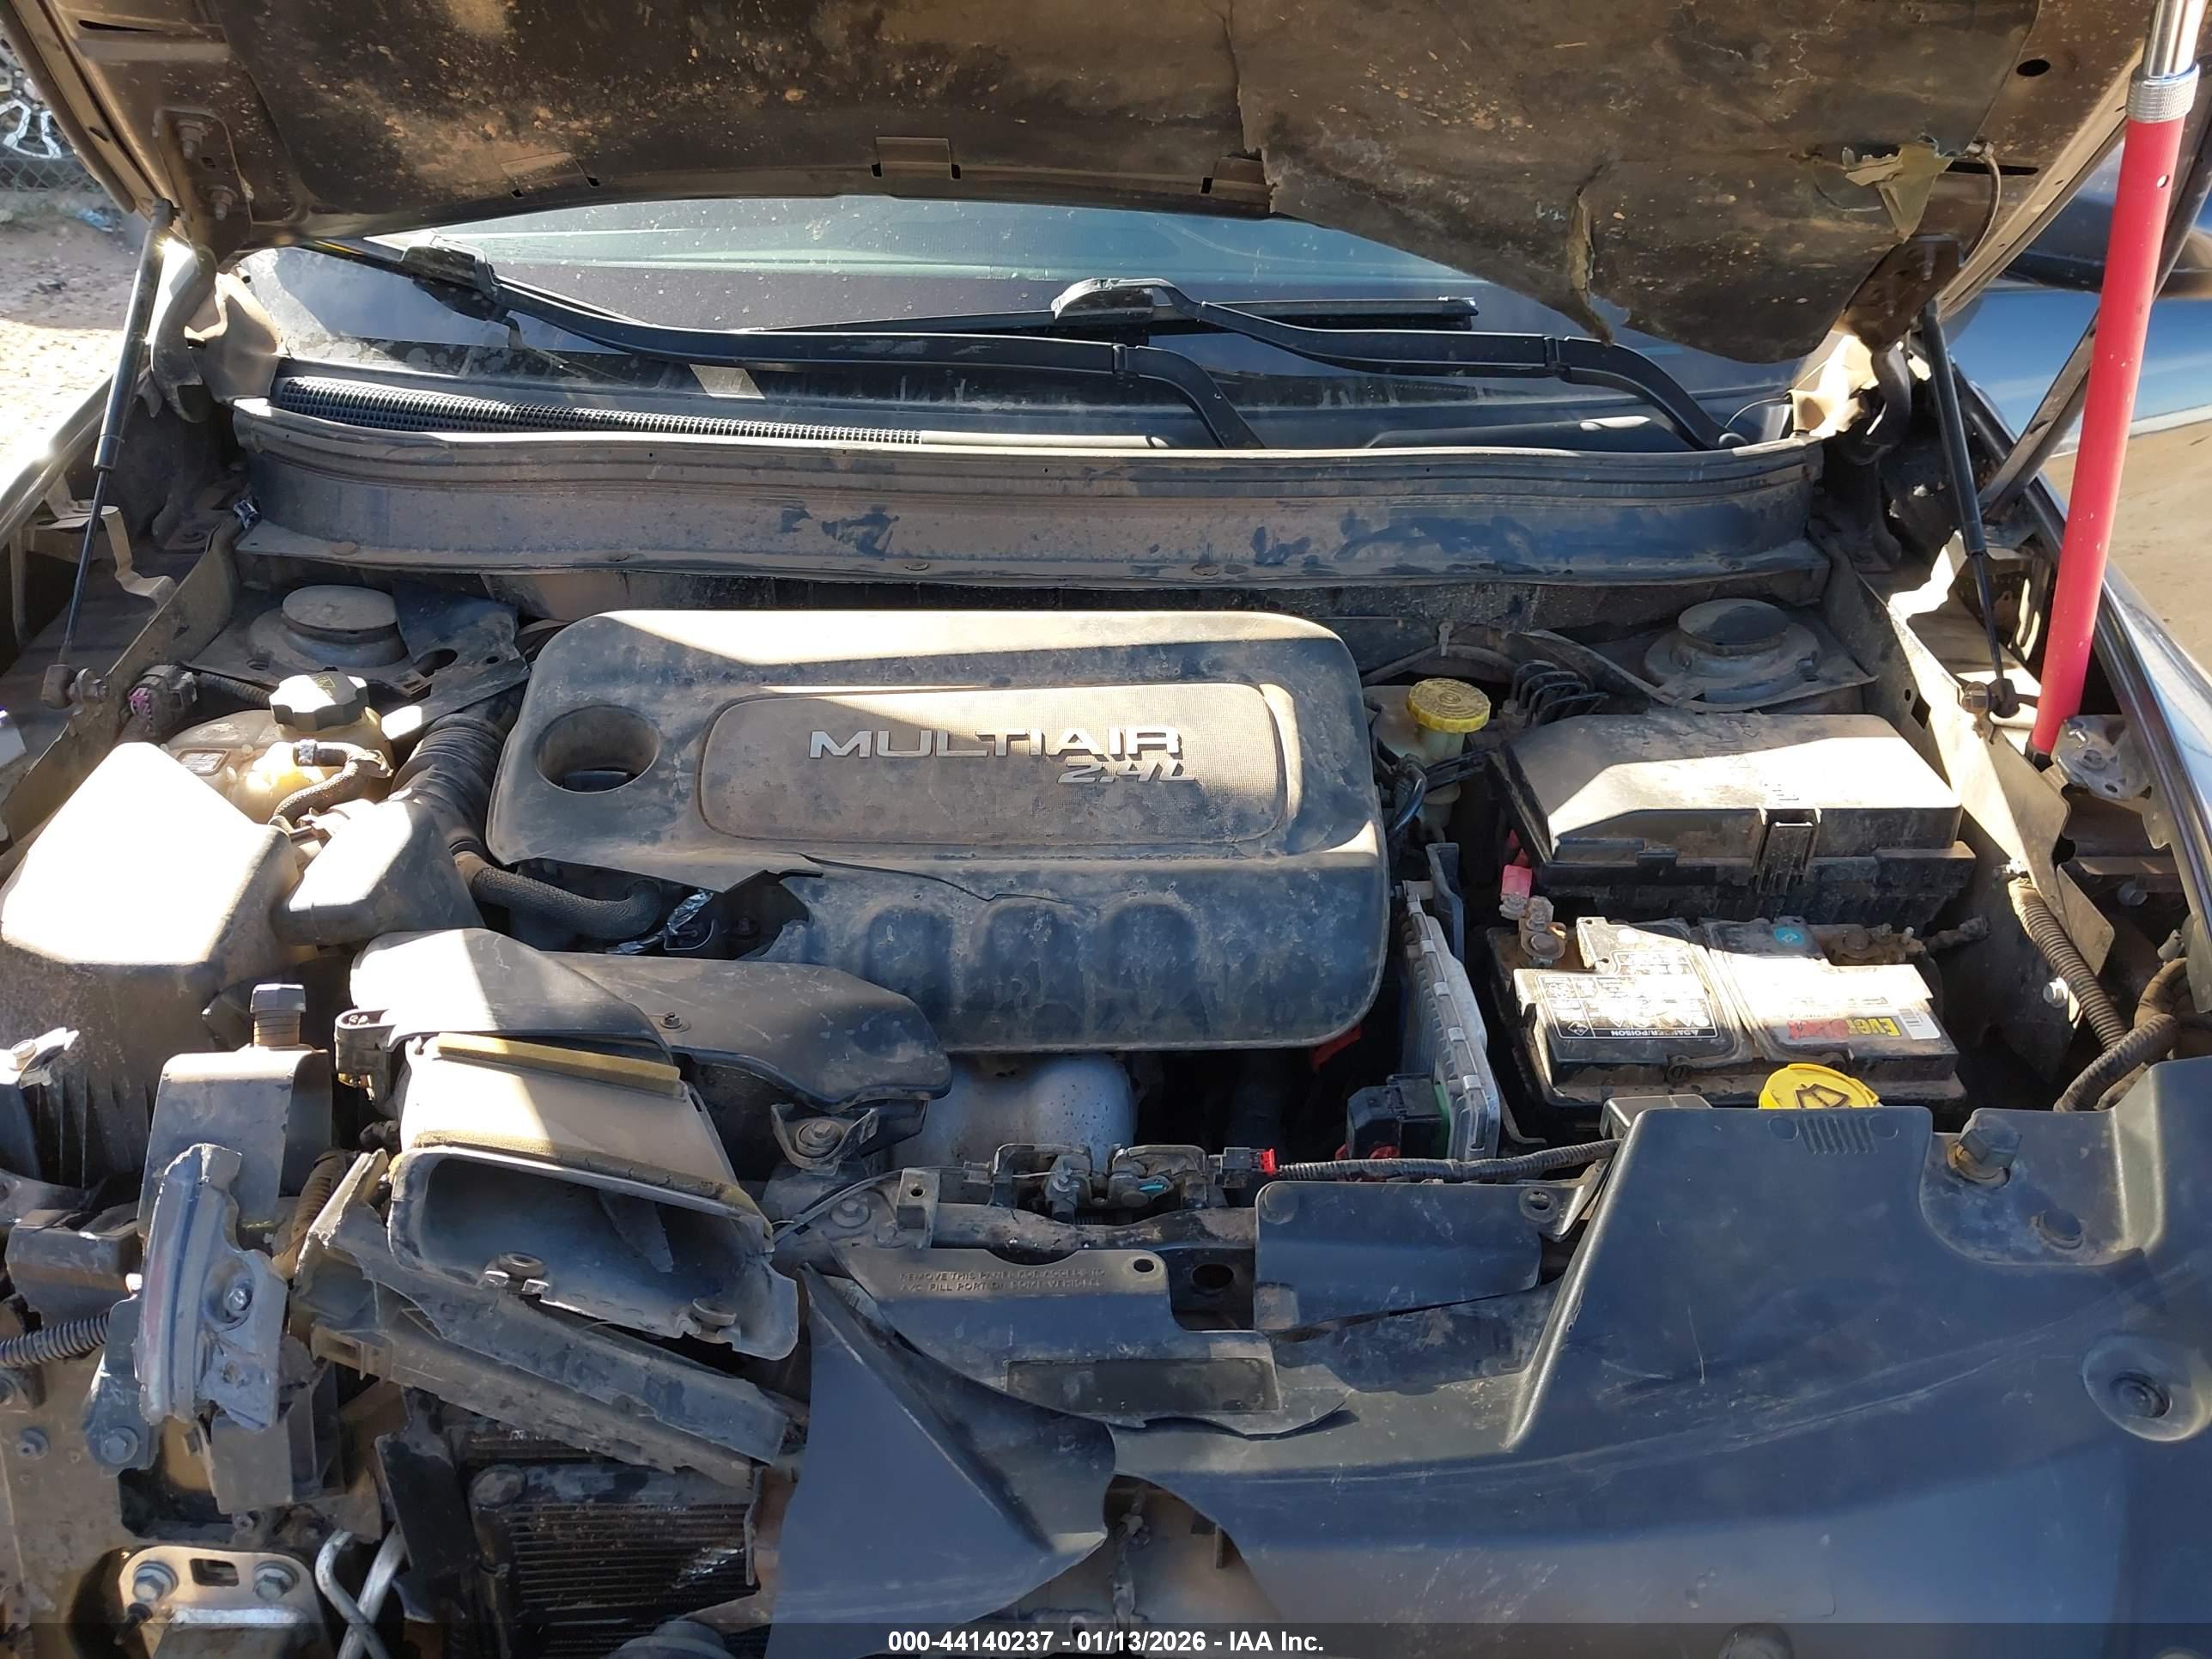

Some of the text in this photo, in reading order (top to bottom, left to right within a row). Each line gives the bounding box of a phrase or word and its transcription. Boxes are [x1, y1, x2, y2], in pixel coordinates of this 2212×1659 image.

[809, 726, 1182, 759] MULTIAIR
[1056, 759, 1198, 784] 2.4L
[899, 1272, 947, 1282] REMOVE
[949, 1271, 976, 1281] THIS
[956, 1281, 987, 1291] PORT
